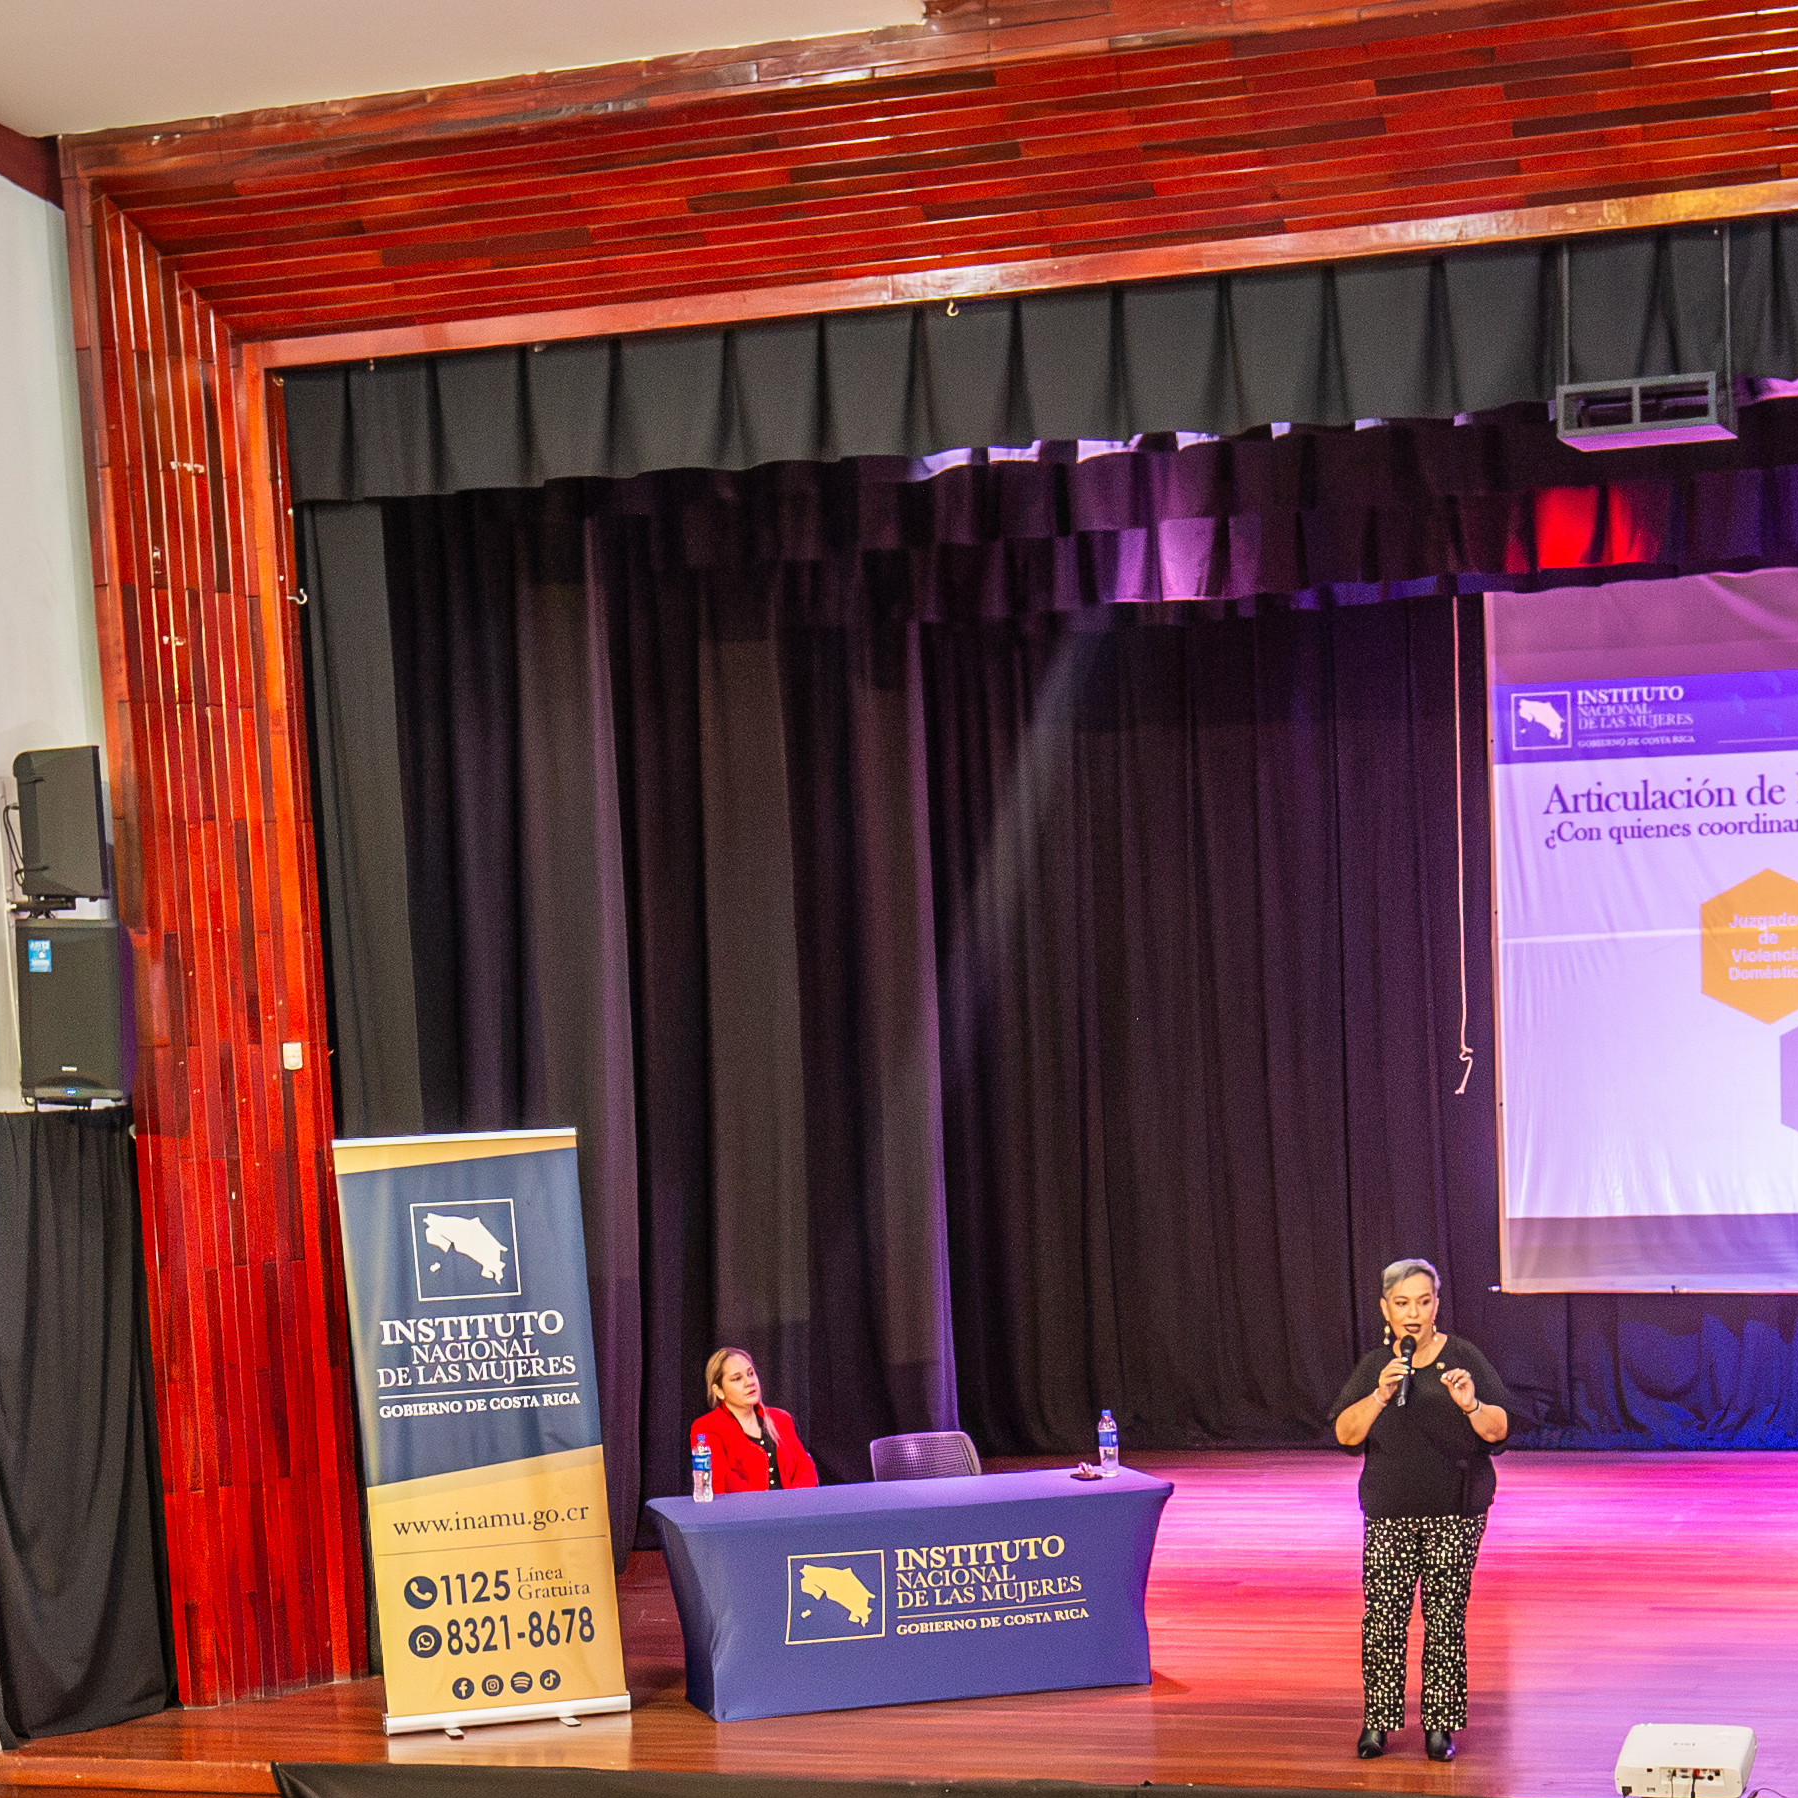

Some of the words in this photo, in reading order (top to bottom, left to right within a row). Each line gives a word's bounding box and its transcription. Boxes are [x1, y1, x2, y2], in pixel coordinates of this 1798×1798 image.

[1577, 686, 1684, 705] INSTITUTO
[1577, 703, 1652, 717] NACIONAL
[1578, 717, 1597, 730] DE
[1601, 715, 1627, 729] LAS
[1628, 713, 1694, 729] MUJERES
[1543, 776, 1737, 815] Articulación
[1746, 774, 1786, 806] de
[1545, 820, 1603, 849] ¿Con
[1608, 817, 1692, 845] quienes
[1759, 932, 1779, 945] de
[379, 1309, 565, 1346] INSTITUTO
[411, 1337, 540, 1365] NACIONAL
[377, 1366, 412, 1388] DE
[416, 1363, 462, 1385] LAS
[466, 1355, 576, 1384] MUJERES
[379, 1400, 463, 1418] GOBIERNO
[465, 1398, 487, 1412] DE
[489, 1395, 539, 1410] COSTA
[542, 1392, 580, 1406] RICA
[393, 1506, 589, 1536] www.inamu.go.cr
[894, 1534, 1065, 1571] INSTITUTO
[440, 1569, 511, 1606] 1125
[515, 1567, 564, 1583] Línea
[896, 1564, 1016, 1591] NACIONAL
[517, 1581, 591, 1601] Gratuita
[897, 1590, 929, 1609] DE
[934, 1586, 976, 1606] LAS
[981, 1575, 1083, 1603] MUJERES
[446, 1606, 595, 1656] 8321-8678
[896, 1619, 977, 1635] GOBIERNO
[979, 1616, 1001, 1629] DE
[1003, 1612, 1052, 1627] COSTA
[1054, 1607, 1090, 1622] RICA
